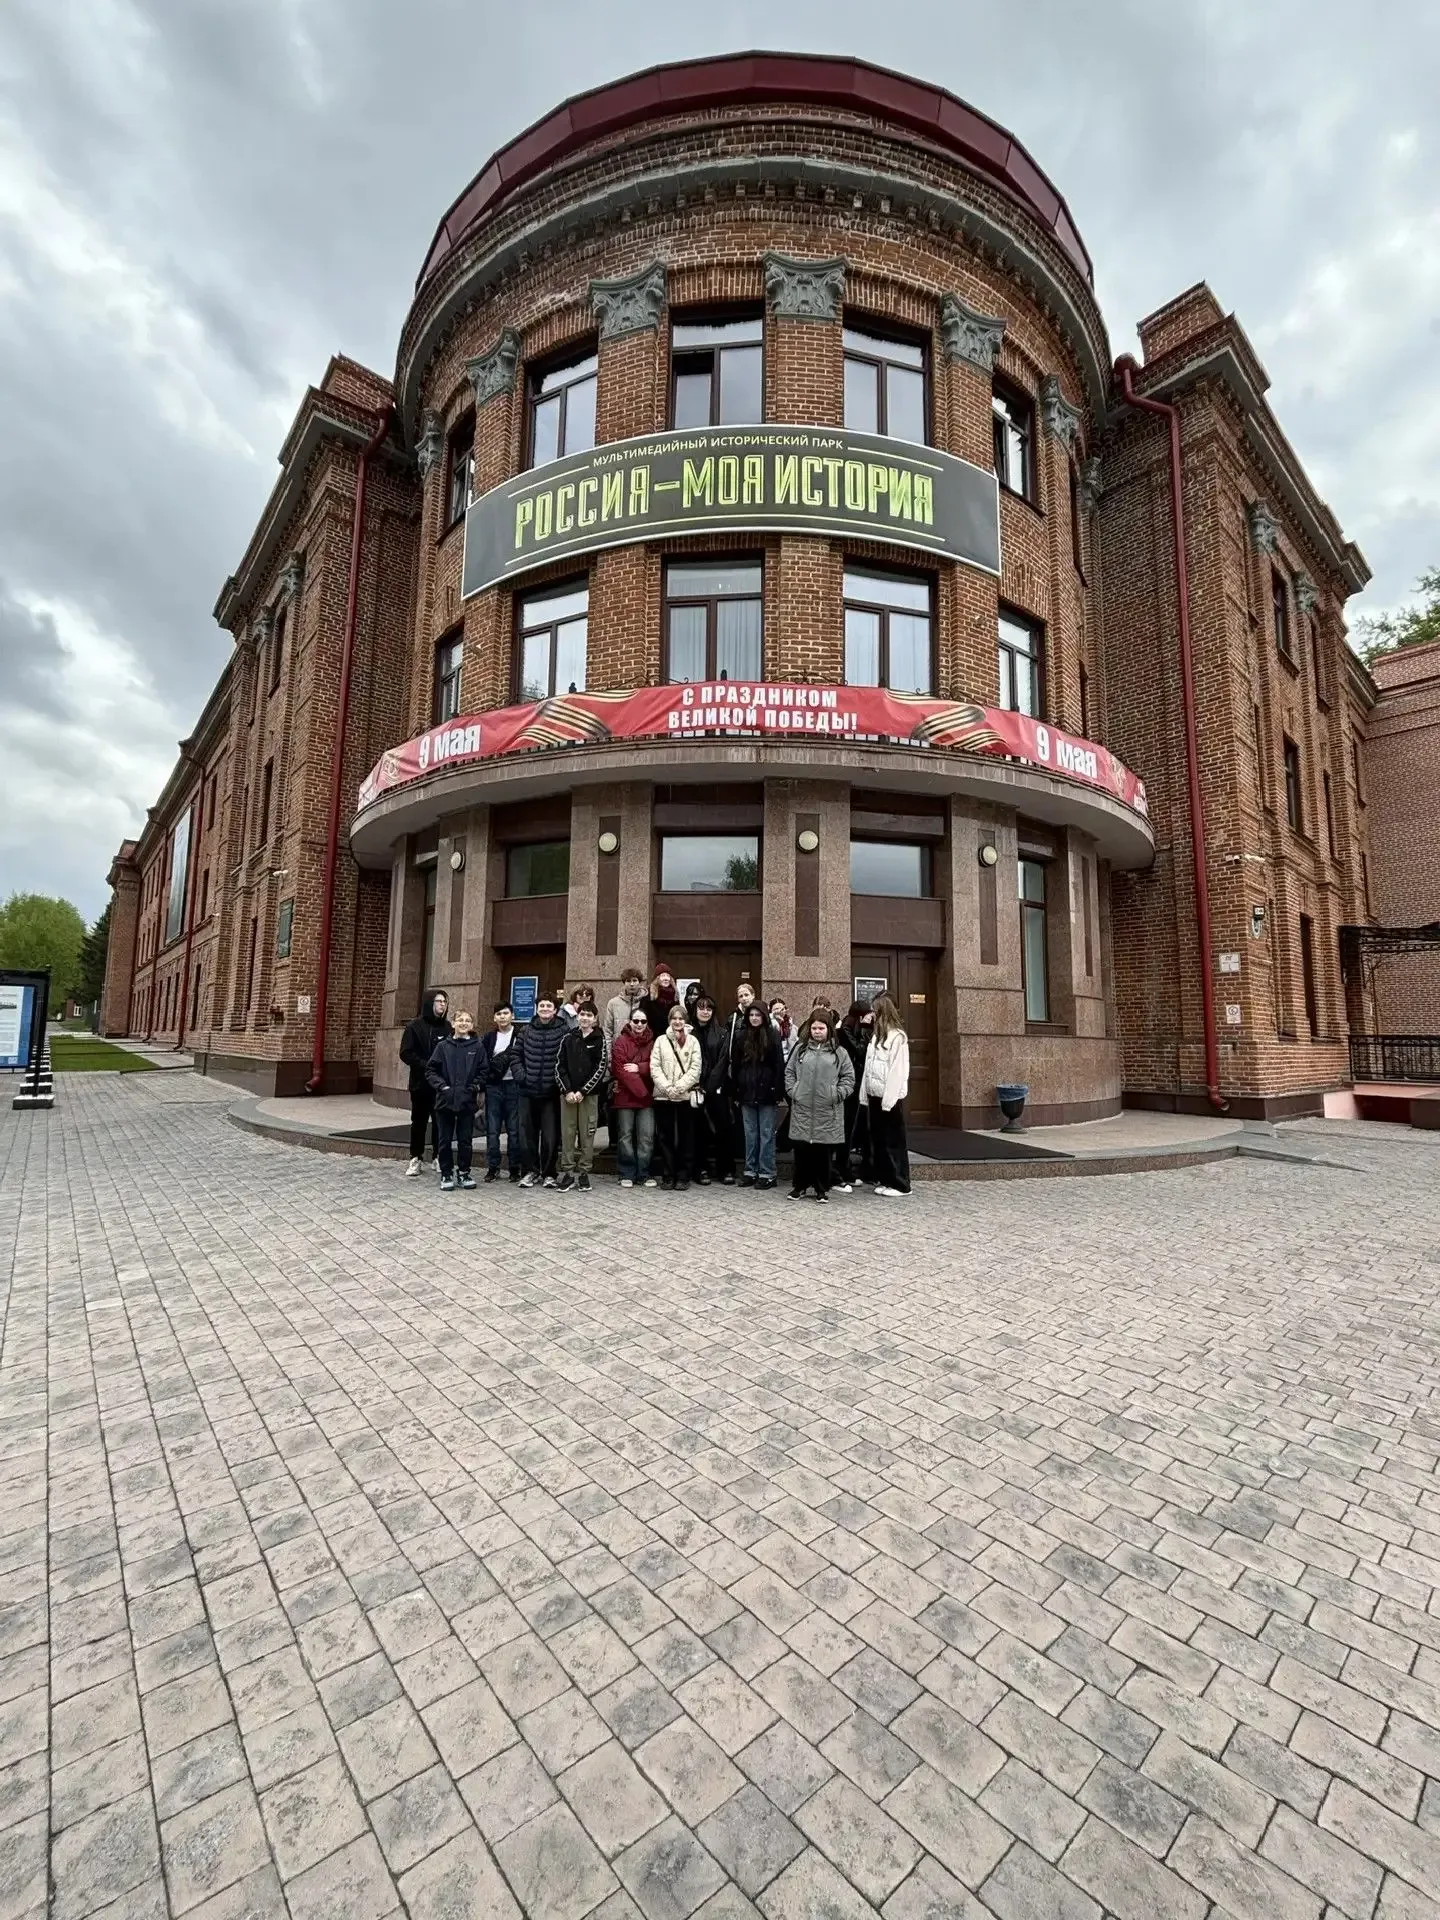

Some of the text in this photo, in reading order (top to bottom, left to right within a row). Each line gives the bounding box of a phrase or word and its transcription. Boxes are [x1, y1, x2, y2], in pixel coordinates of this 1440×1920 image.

[593, 435, 844, 467] МУЛЬТИМЕДИЙНЫЙ ИСТОРИЧЕСКИЙ ПАРК
[515, 464, 650, 549] РОССИЯ
[683, 454, 764, 508] МОЯ
[775, 454, 934, 525] ИСТОРИЯ
[682, 686, 837, 708] С ПРАЗДНИКОМ
[668, 705, 857, 732] ВЕЛИКОЙ ПОБЕДЫ!
[419, 735, 431, 769] 9
[1036, 726, 1050, 761] 9
